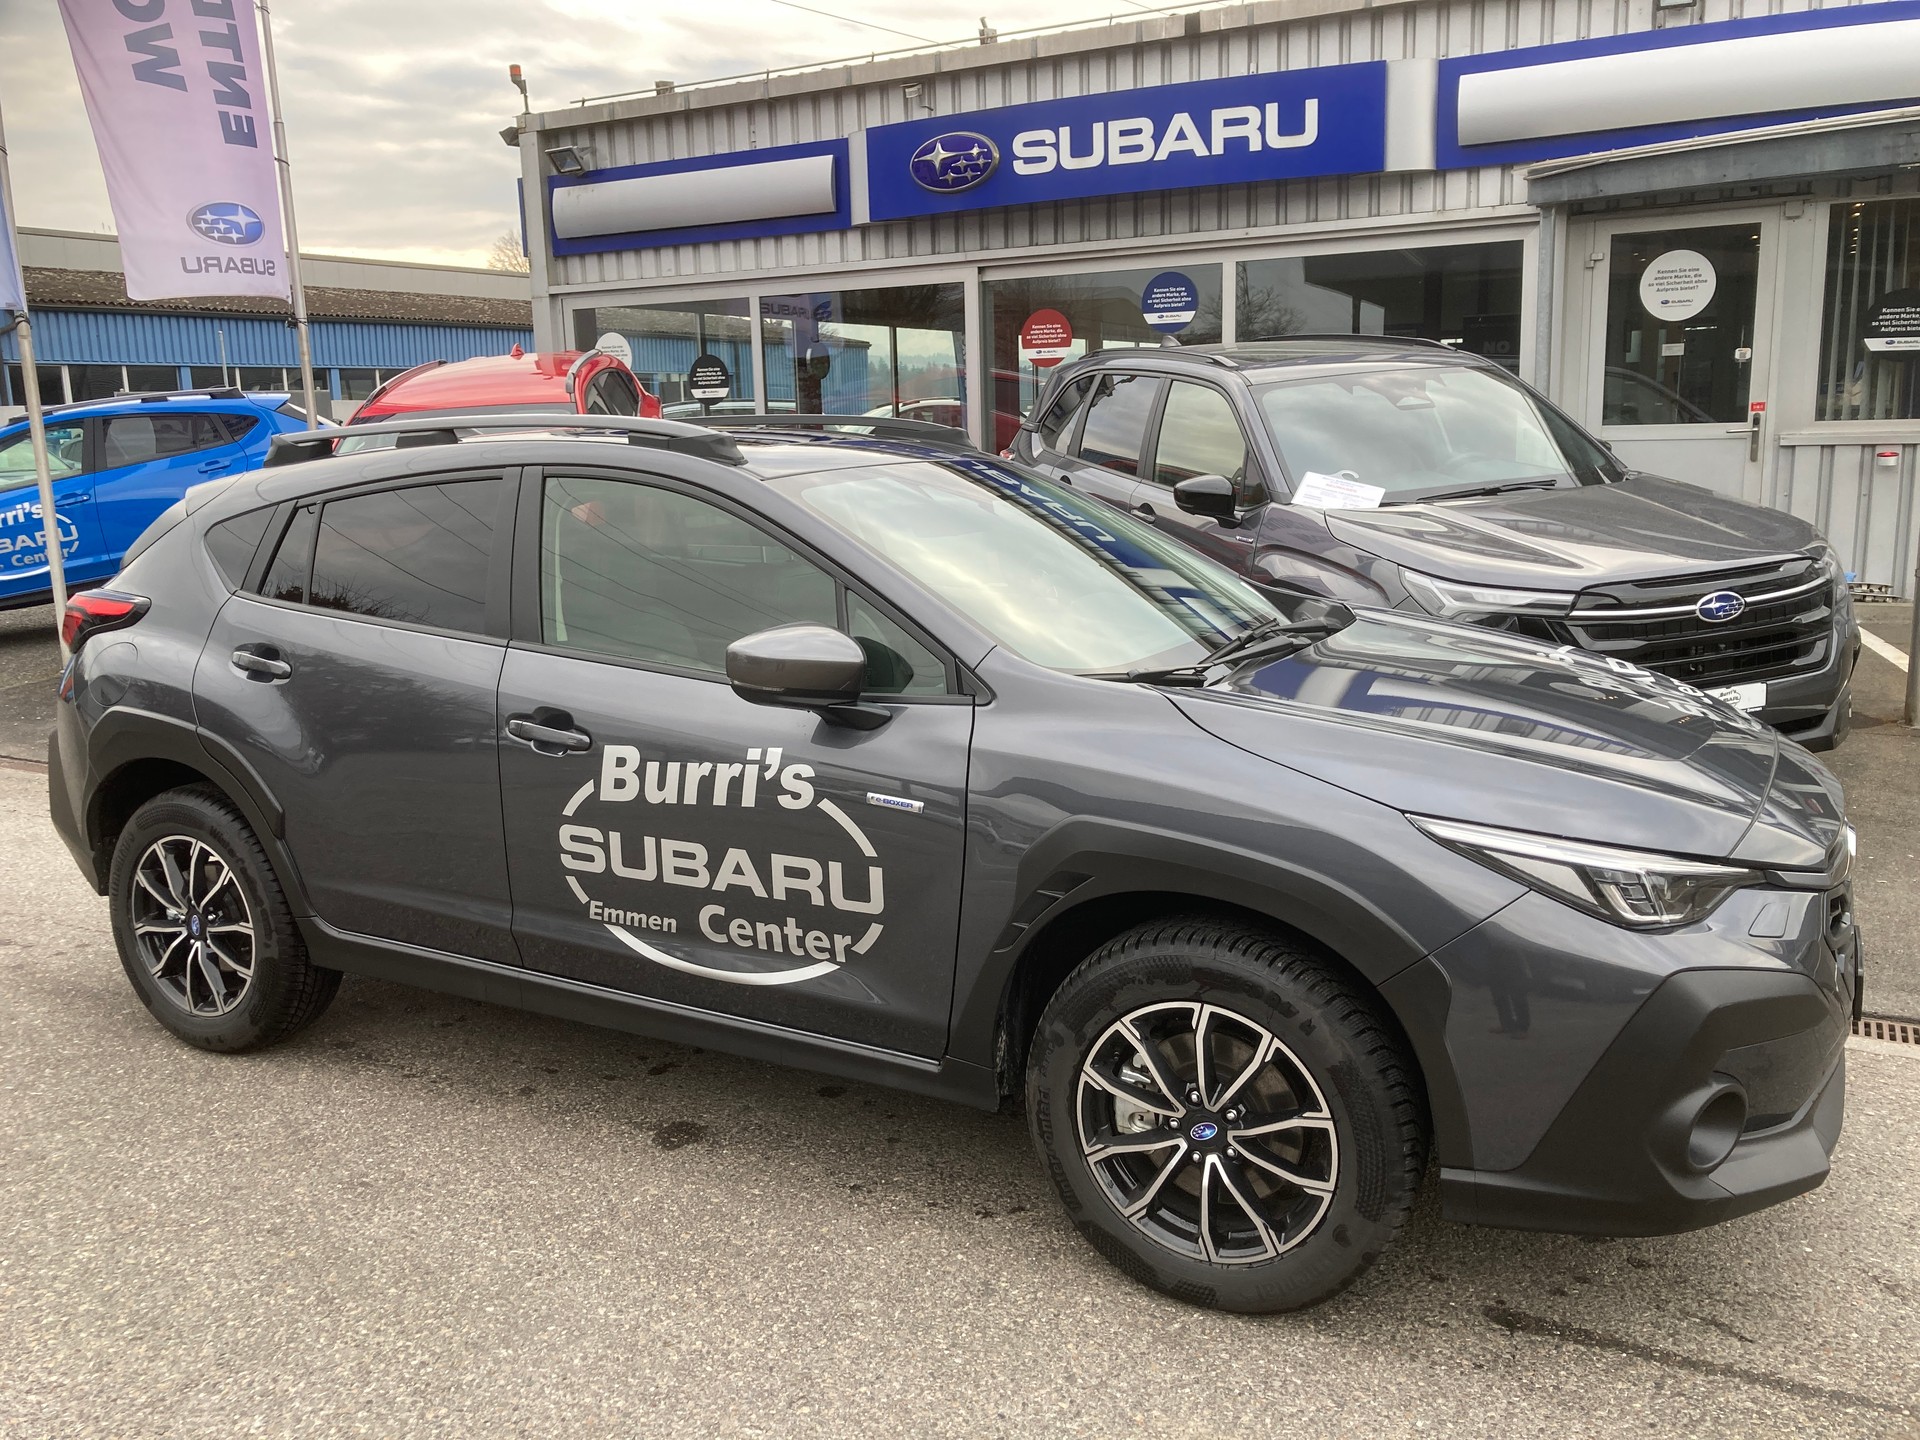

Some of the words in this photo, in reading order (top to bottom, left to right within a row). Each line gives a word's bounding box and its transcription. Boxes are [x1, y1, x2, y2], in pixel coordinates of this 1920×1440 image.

[1012, 98, 1319, 175] SUBARU
[11, 548, 70, 567] Cenr
[600, 744, 817, 810] Burri's
[875, 797, 914, 808] e-BOXER
[559, 823, 885, 915] SUBARU
[589, 900, 677, 933] Emmen
[699, 904, 853, 963] Center
